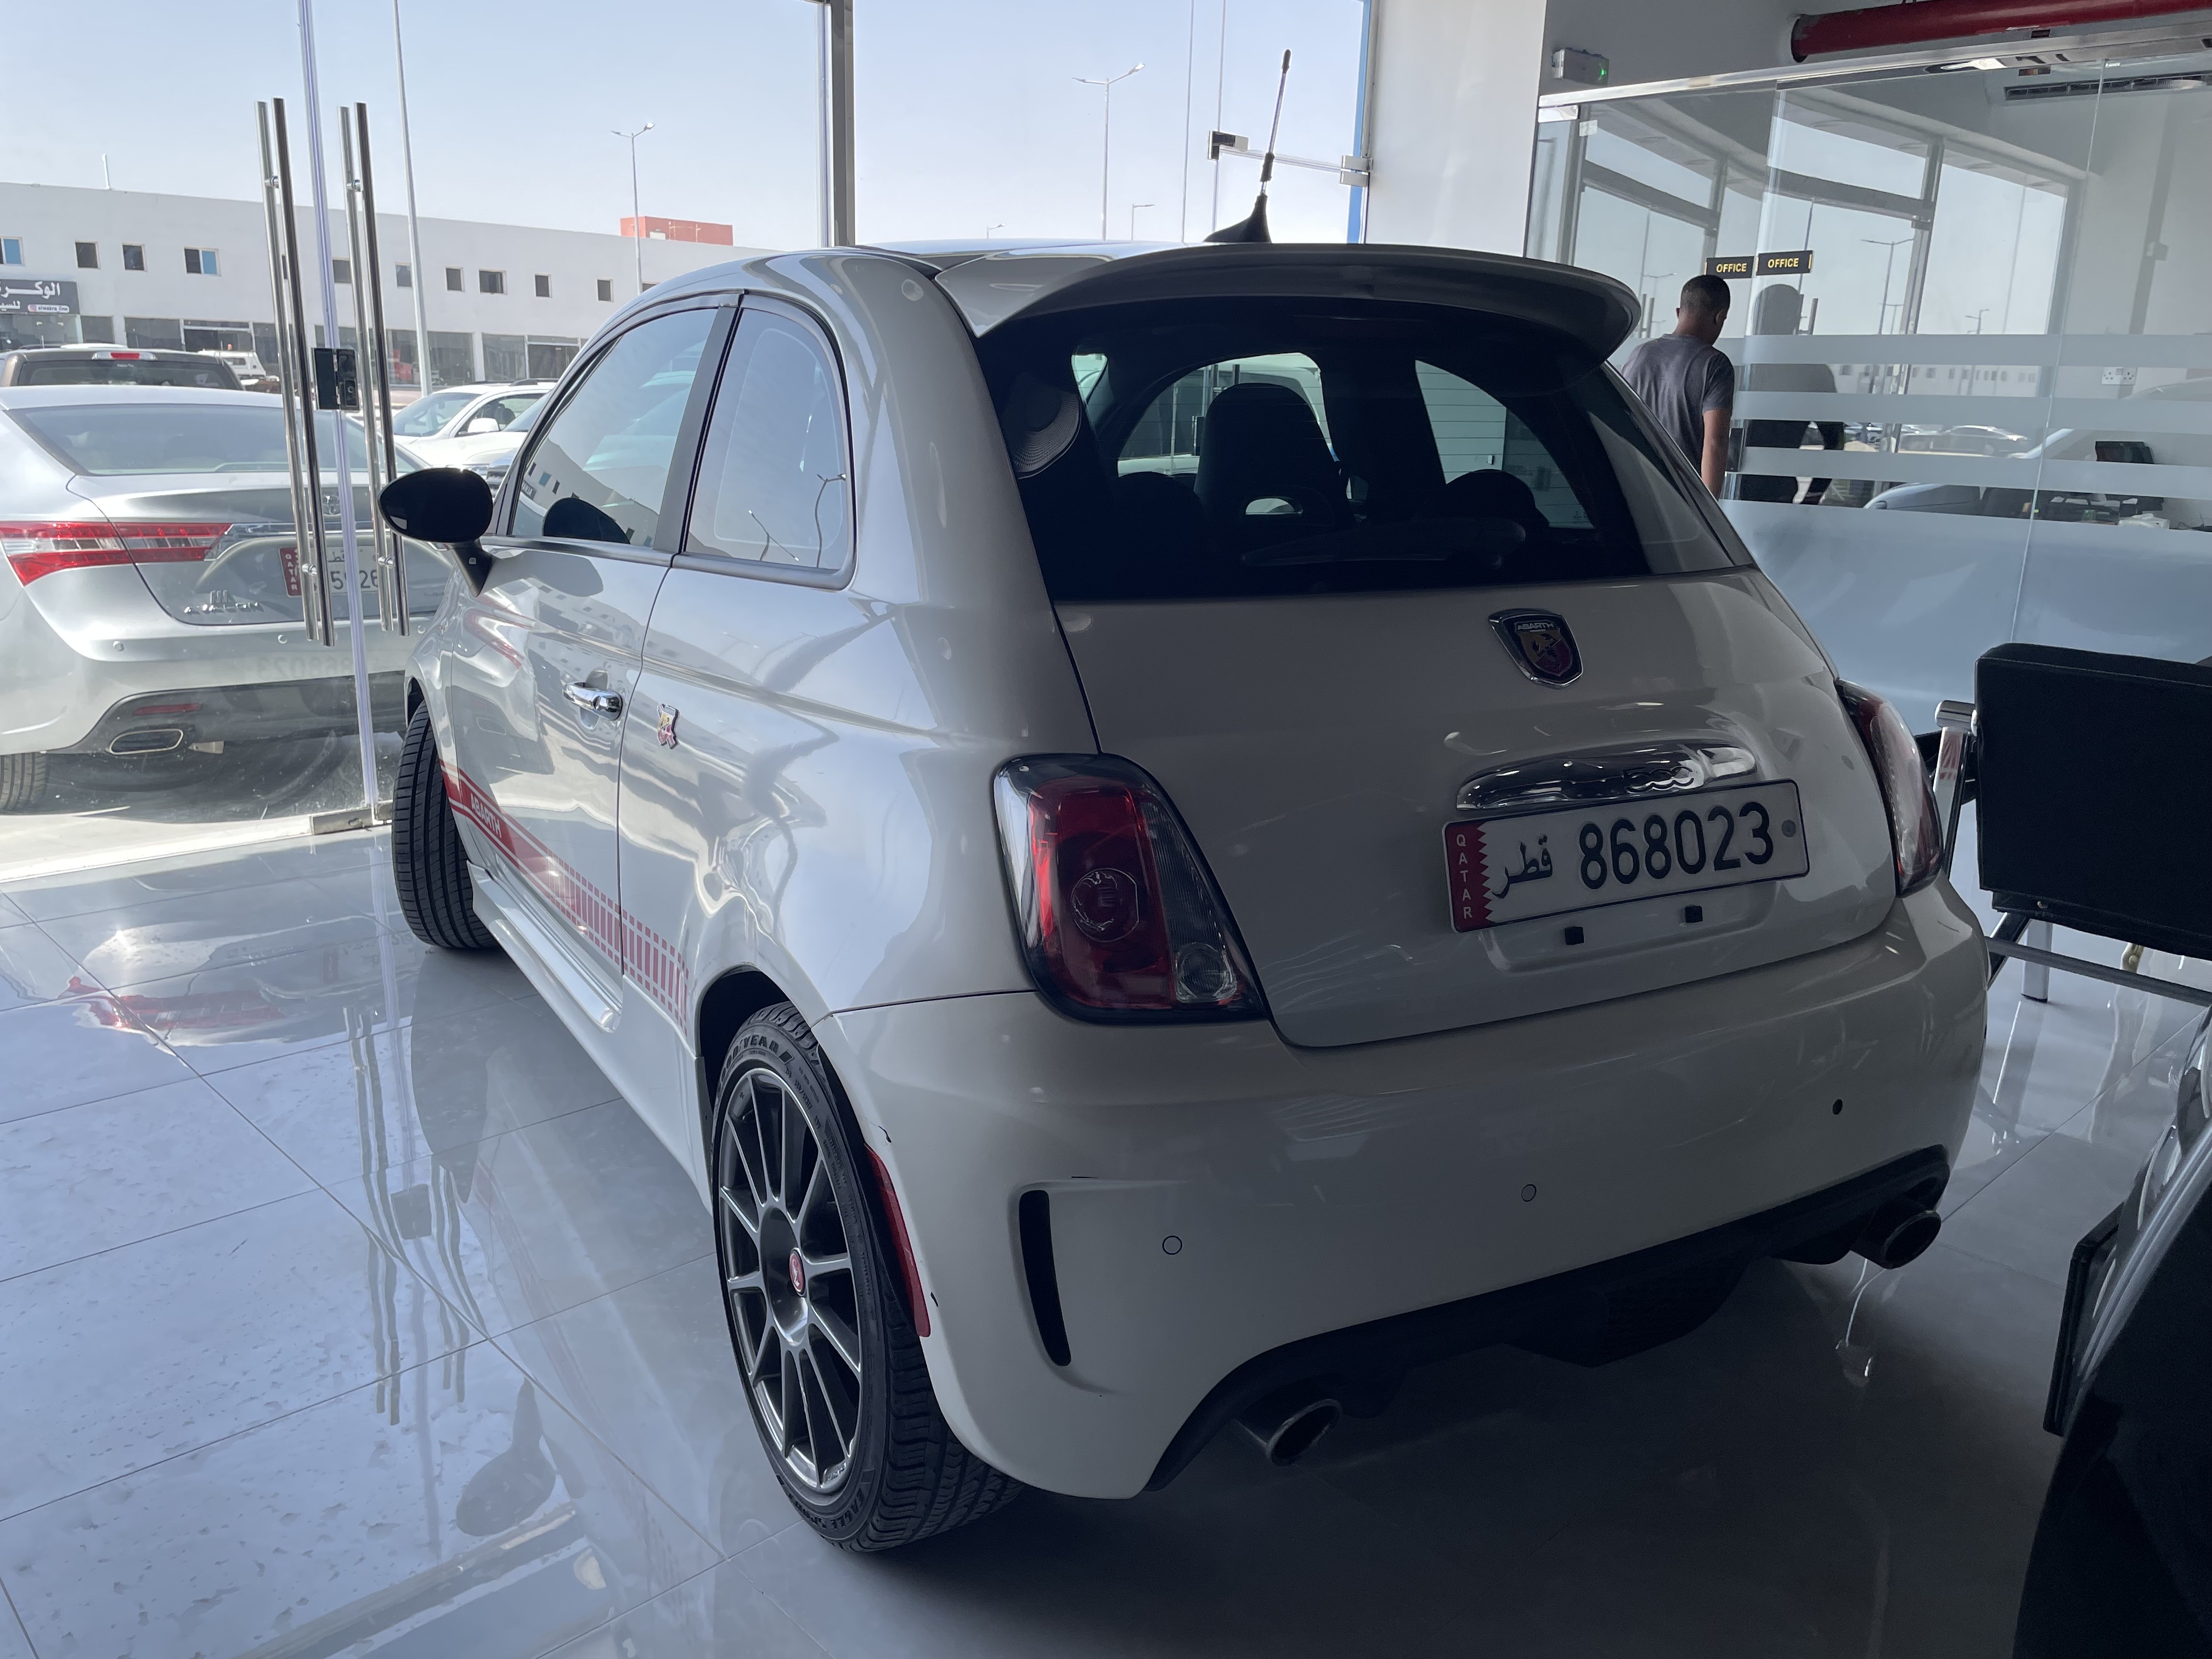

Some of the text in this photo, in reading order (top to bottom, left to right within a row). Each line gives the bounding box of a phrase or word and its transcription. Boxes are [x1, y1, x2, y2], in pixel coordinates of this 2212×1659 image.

[1716, 263, 1747, 273] OFFICE
[1767, 257, 1799, 268] OFFICE
[0, 281, 60, 300] الوكر
[0, 300, 20, 312] للسي
[285, 554, 298, 590] QATAR
[1517, 622, 1554, 630] ABARTH
[471, 793, 502, 838] ABARTH
[1578, 802, 1774, 890] 868023
[1456, 834, 1472, 919] QATAR
[1491, 834, 1554, 899] قطر
